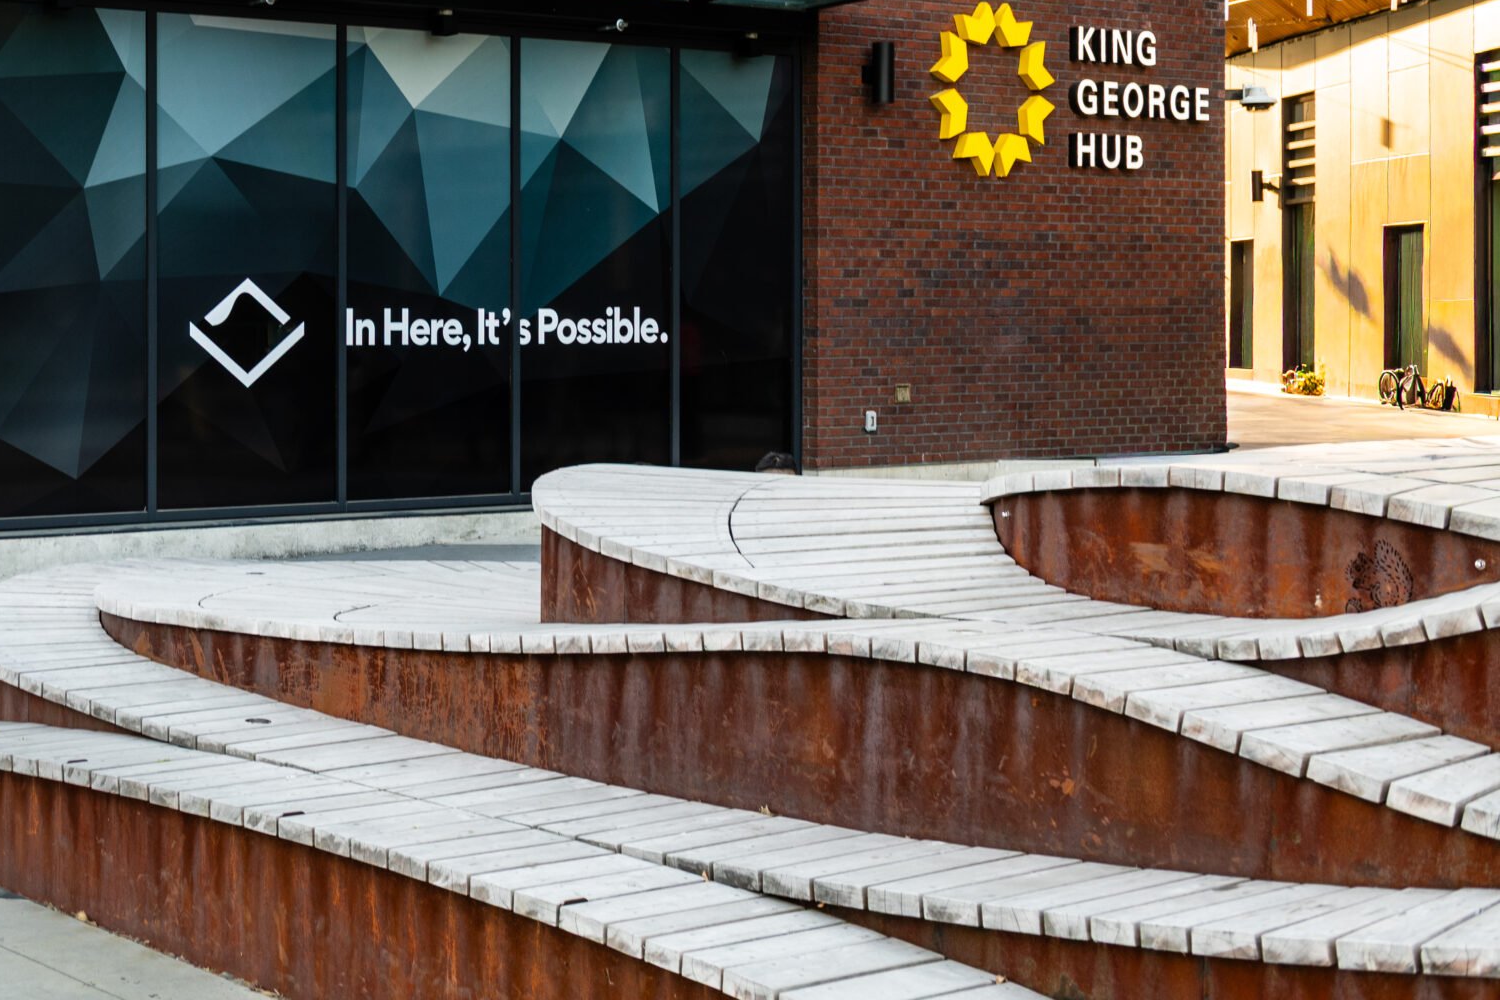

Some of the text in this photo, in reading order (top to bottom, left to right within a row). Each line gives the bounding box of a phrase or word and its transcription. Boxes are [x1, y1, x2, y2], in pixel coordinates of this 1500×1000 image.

[1077, 25, 1157, 67] KING
[1076, 78, 1210, 121] GEORGE
[1076, 131, 1144, 170] HUB
[345, 307, 376, 346] In
[383, 307, 471, 352] Here,
[537, 306, 668, 345] Possible.
